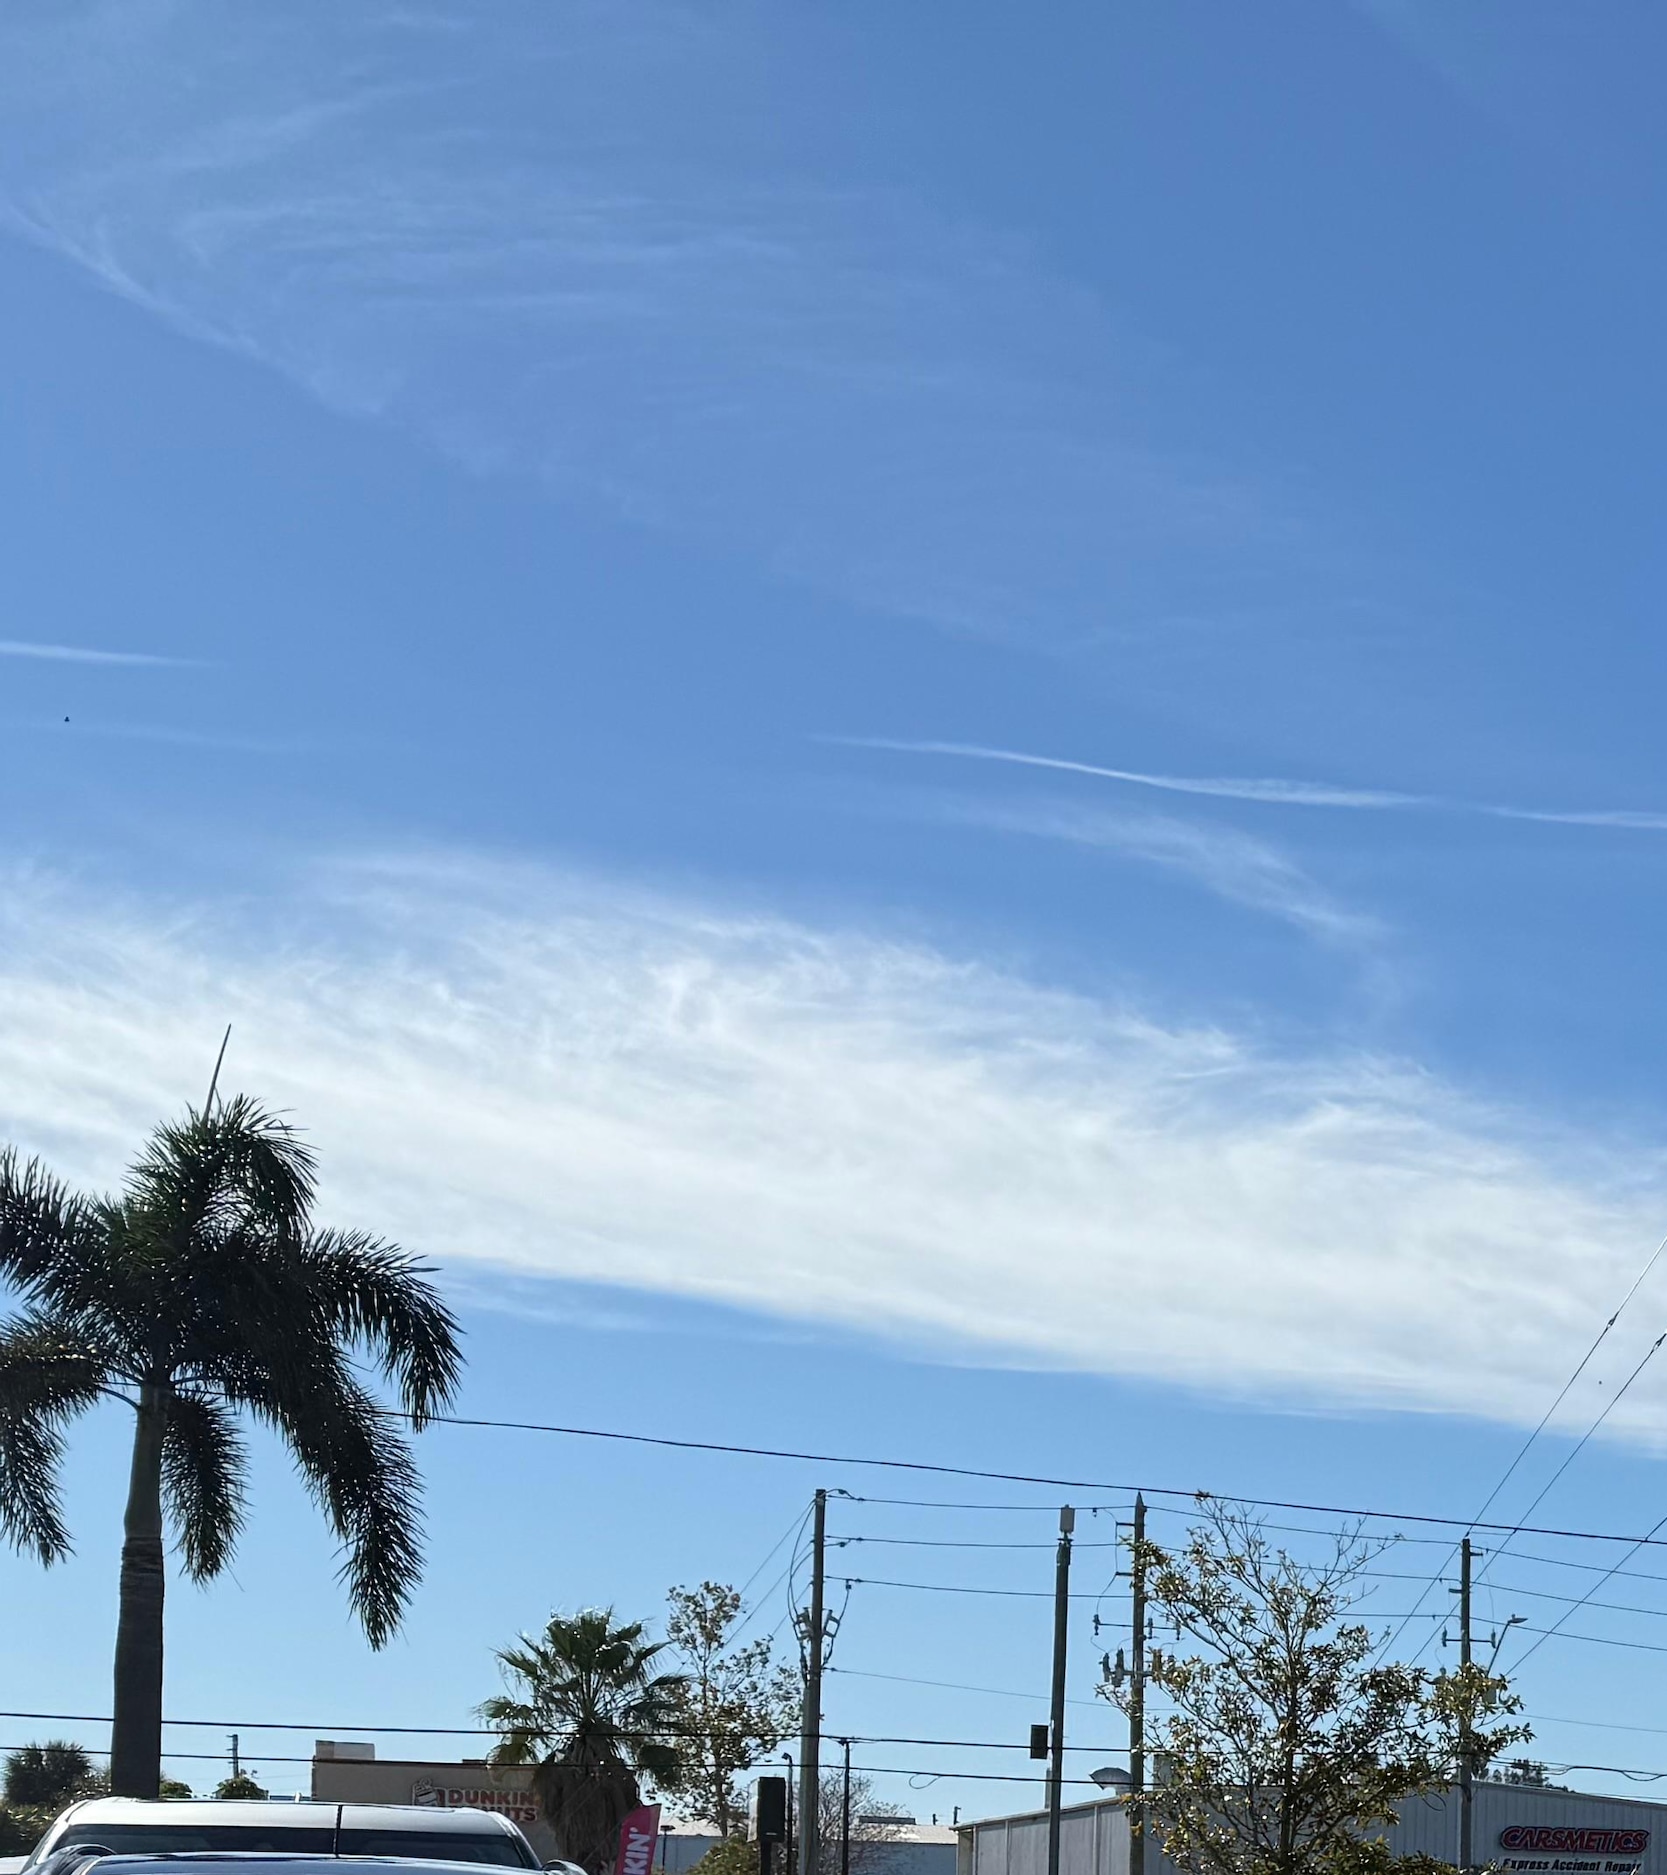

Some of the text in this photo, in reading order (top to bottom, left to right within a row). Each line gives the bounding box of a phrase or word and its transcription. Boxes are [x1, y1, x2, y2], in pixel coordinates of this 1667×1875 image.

[1500, 1826, 1649, 1854] CARSMETICS
[1503, 1858, 1642, 1873] Express Accident Repair
